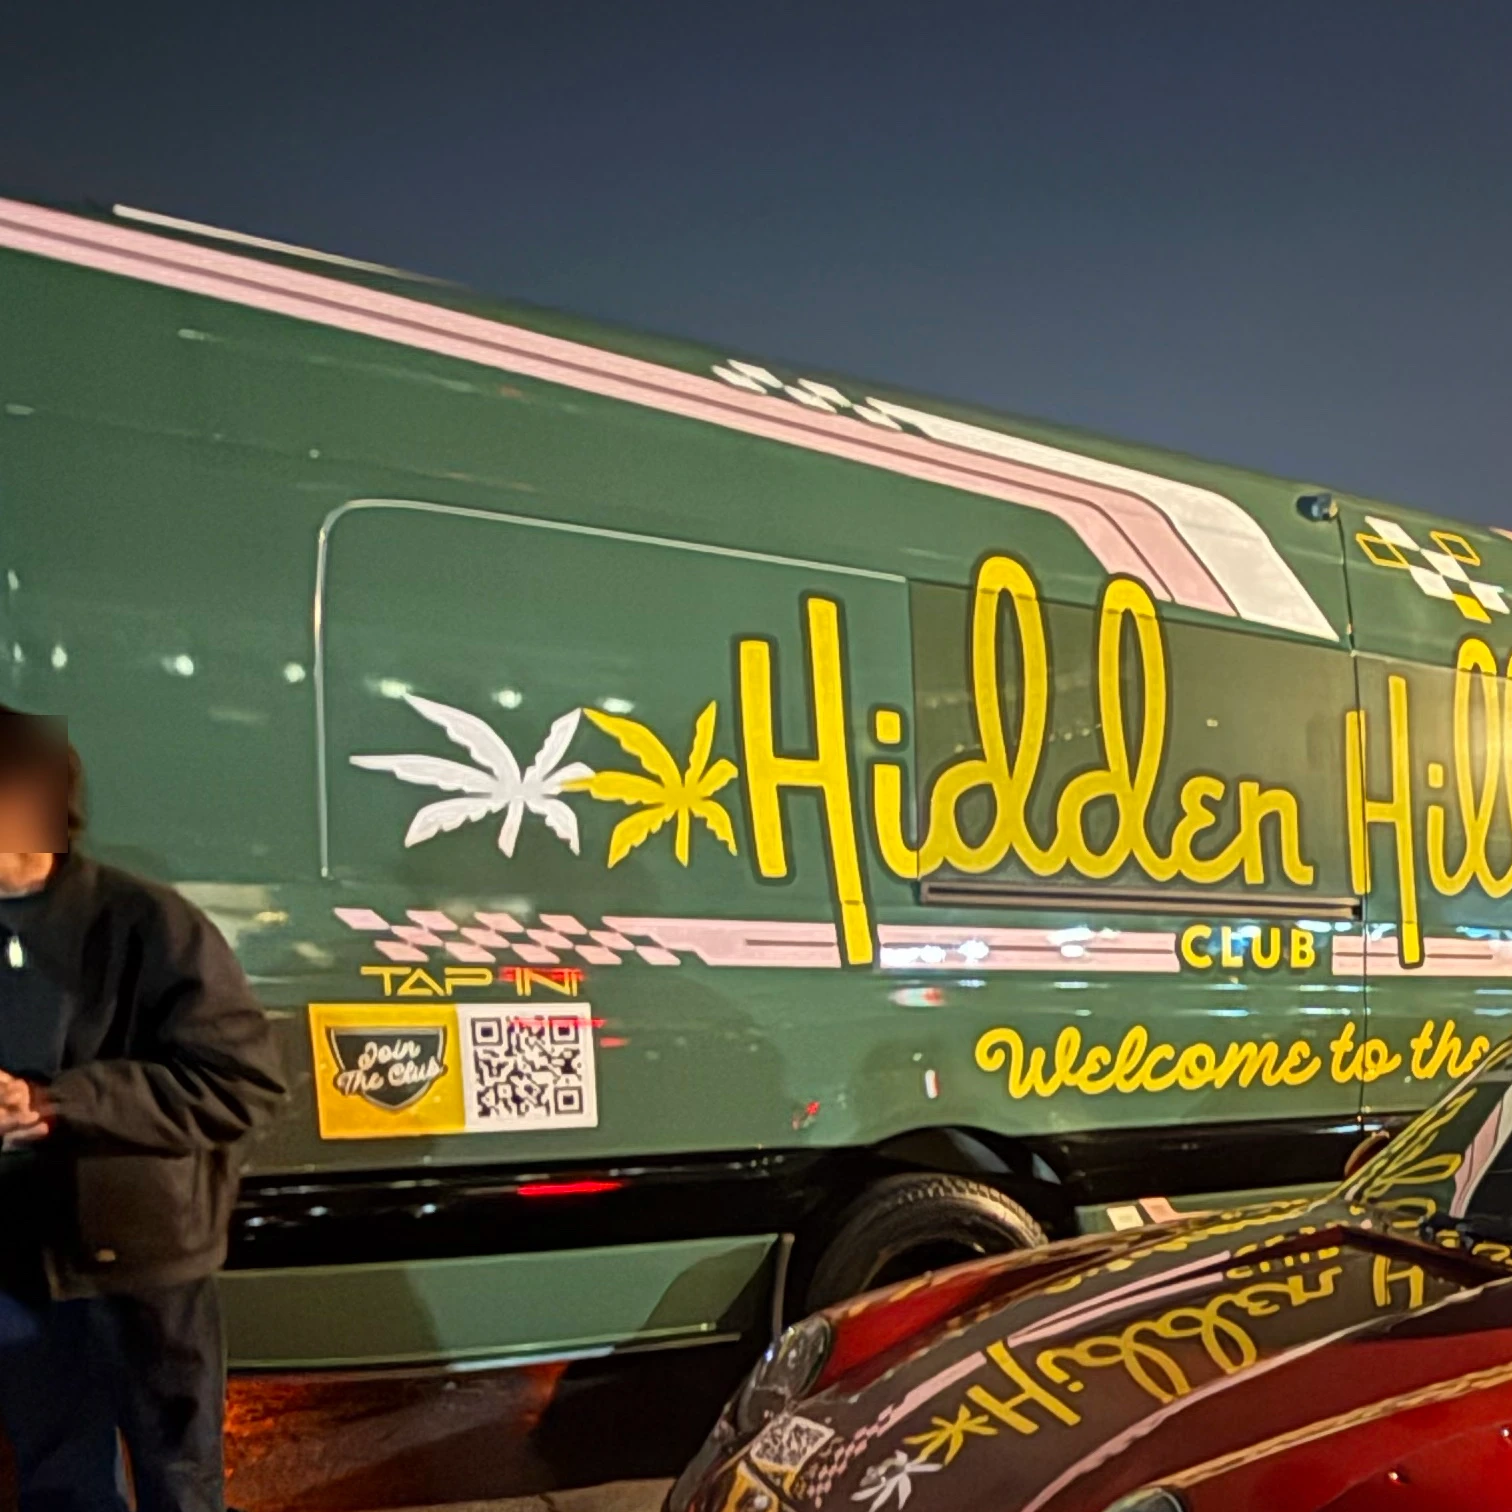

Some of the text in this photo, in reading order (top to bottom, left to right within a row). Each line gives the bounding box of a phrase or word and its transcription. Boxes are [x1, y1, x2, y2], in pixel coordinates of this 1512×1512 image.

[737, 556, 1314, 966] Hidden
[1181, 924, 1317, 970] CLUB
[361, 966, 493, 997] TAP
[337, 1055, 444, 1097] The Club
[358, 1039, 421, 1072] Join
[975, 1019, 1490, 1100] Welcome to the
